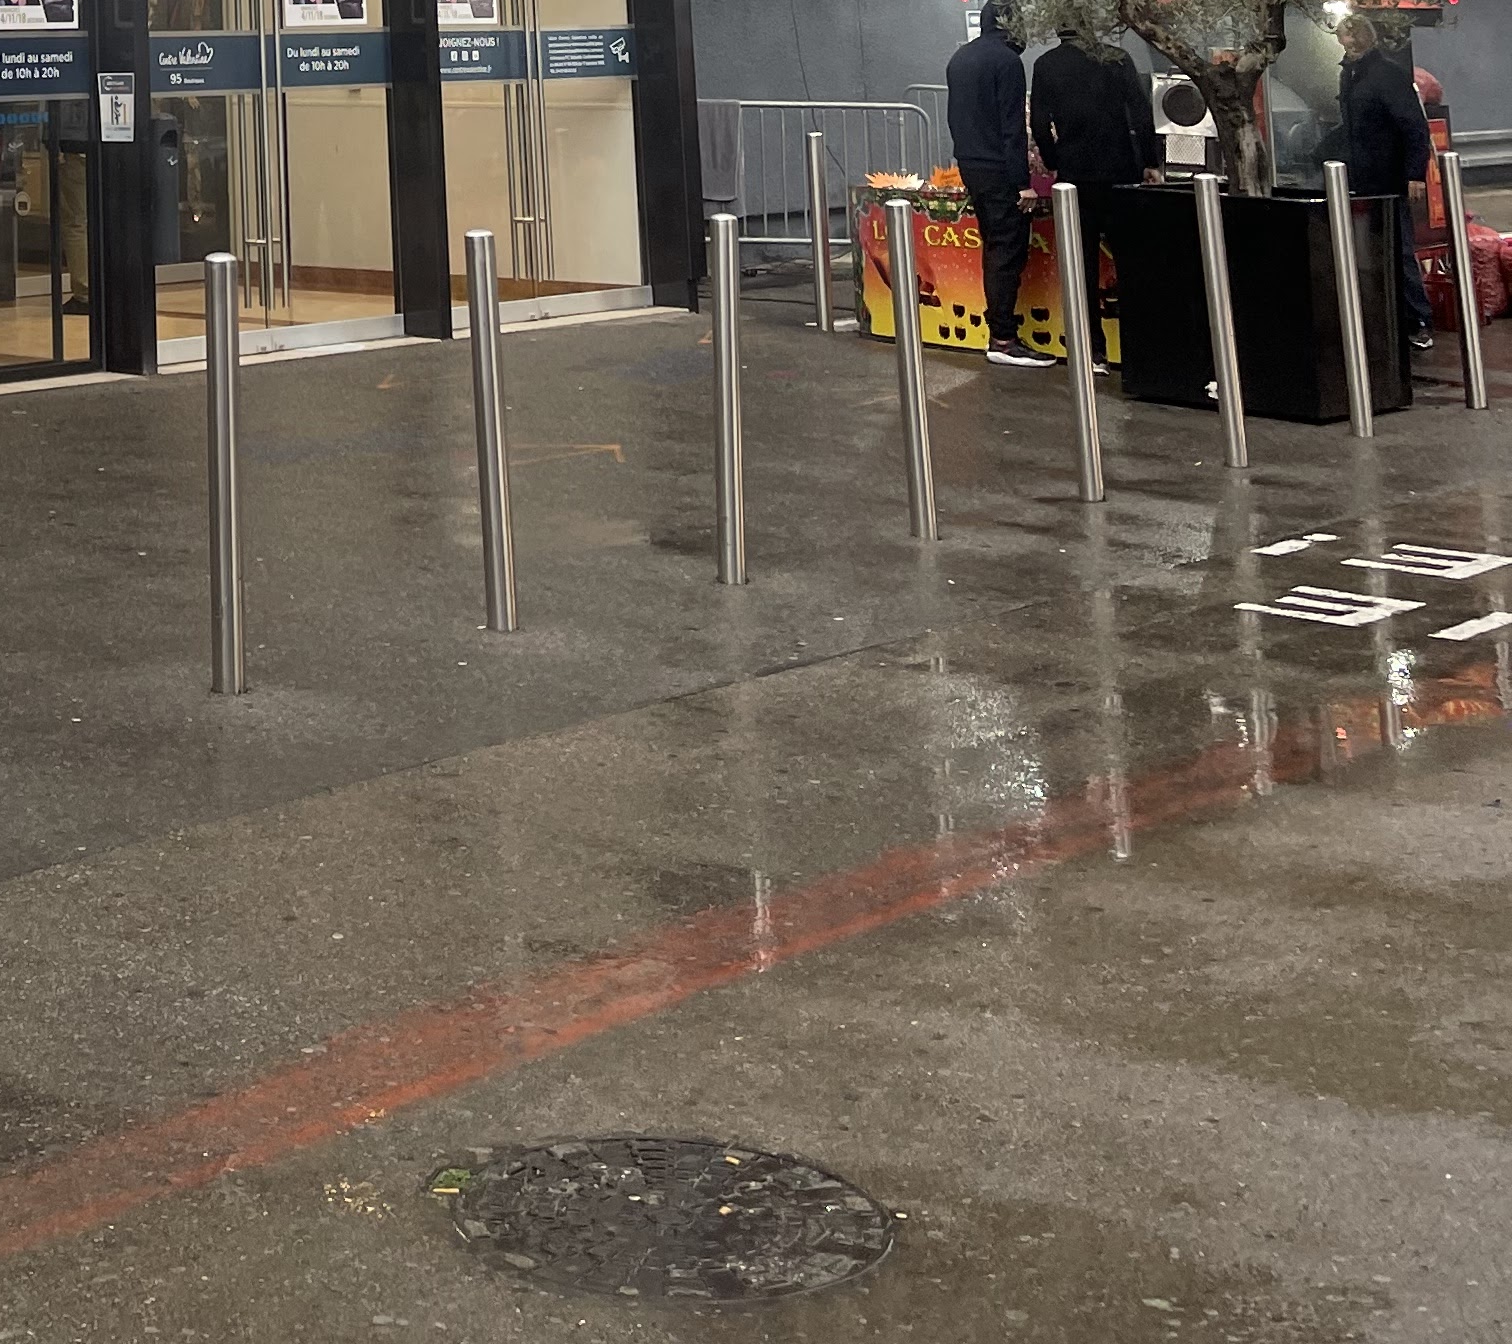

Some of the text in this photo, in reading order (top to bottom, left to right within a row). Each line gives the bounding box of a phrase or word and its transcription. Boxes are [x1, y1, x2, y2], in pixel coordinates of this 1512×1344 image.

[2, 52, 25, 63] lundi
[27, 53, 39, 63] au
[41, 51, 73, 62] samedi
[287, 47, 298, 58] Du
[300, 46, 320, 57] lundi
[332, 45, 360, 56] samedi
[299, 61, 310, 72] de
[311, 61, 325, 71] 10h
[333, 60, 349, 71] 20h
[1, 68, 13, 79] de
[15, 68, 31, 79] 10h
[42, 67, 59, 78] 20h
[170, 73, 182, 84] 95
